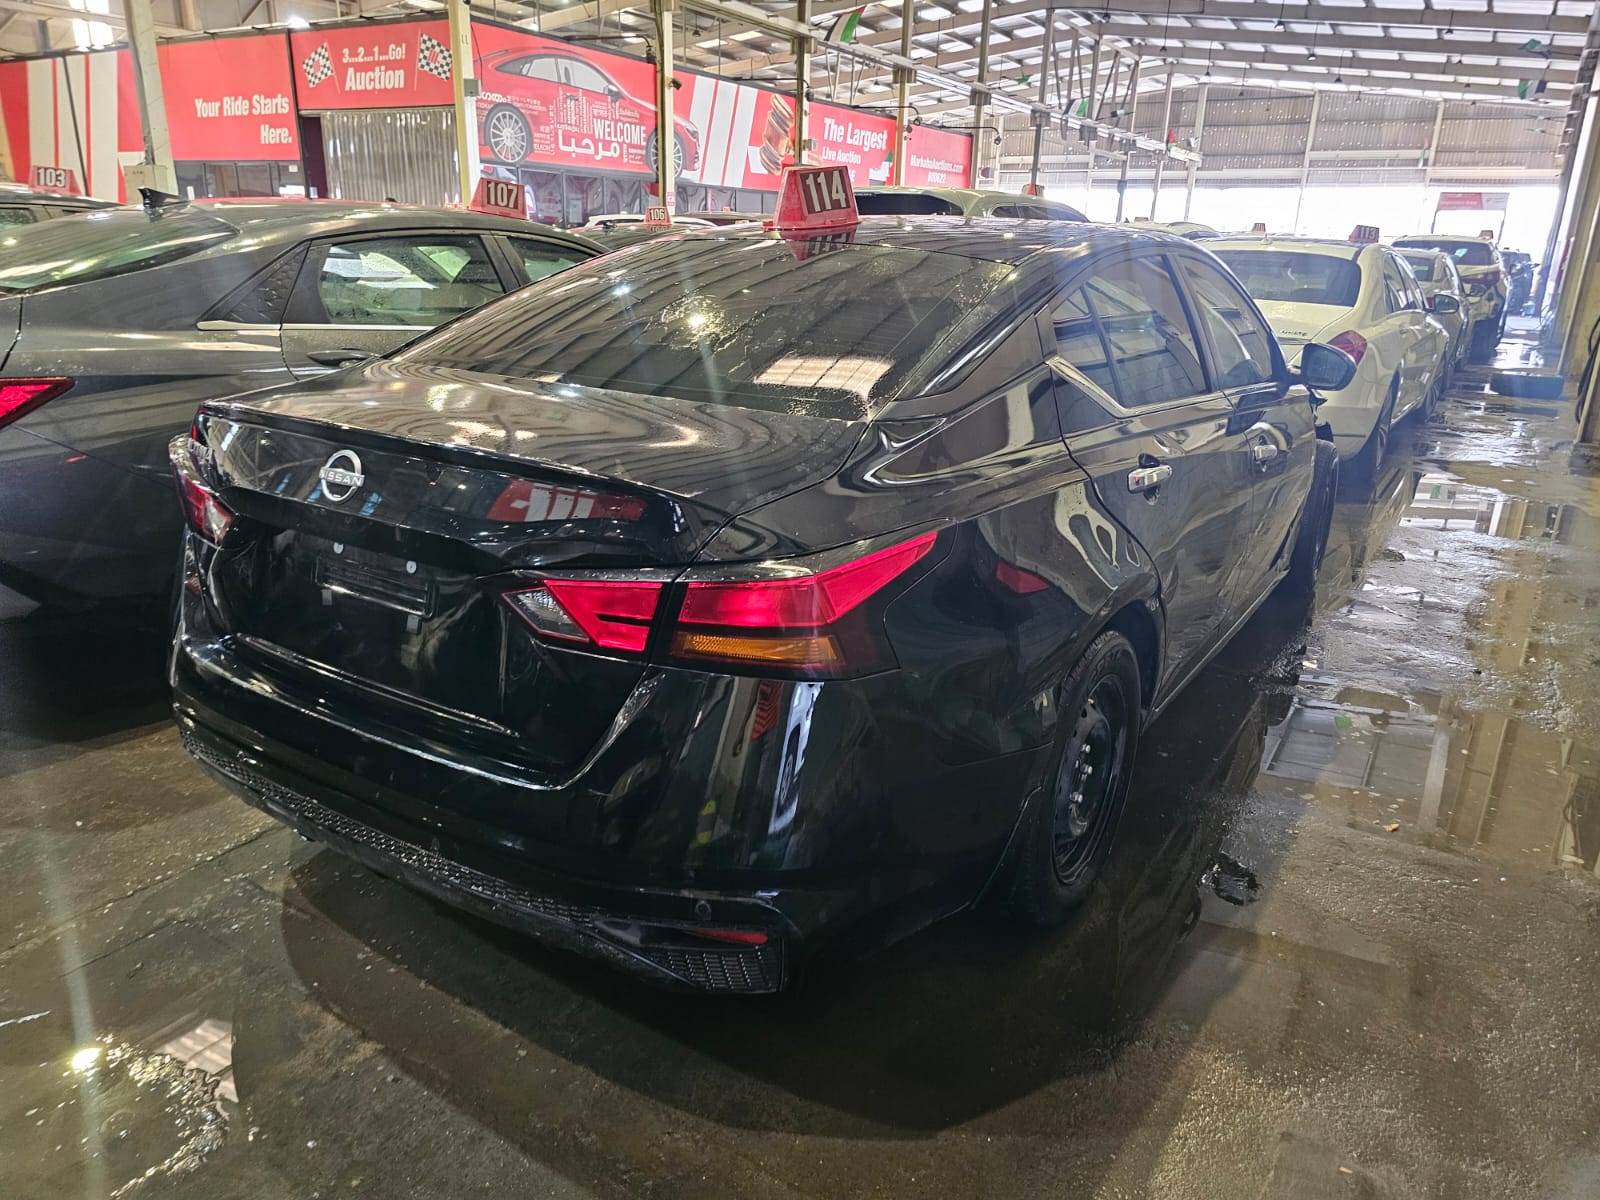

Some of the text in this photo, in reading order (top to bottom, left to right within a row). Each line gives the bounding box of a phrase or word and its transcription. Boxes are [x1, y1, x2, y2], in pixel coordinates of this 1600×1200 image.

[345, 65, 405, 91] Auction
[195, 94, 290, 118] Your Ride Starts
[260, 124, 292, 145] Here.
[558, 128, 620, 160] مرحبا
[593, 118, 647, 146] WELCOME
[824, 118, 887, 151] The Largest
[822, 147, 862, 165] Live Auction
[37, 168, 66, 188] 103
[487, 182, 518, 209] 107
[806, 170, 847, 213] 114
[650, 208, 665, 220] 106
[1360, 228, 1375, 241] 113
[319, 467, 364, 487] NISSAN
